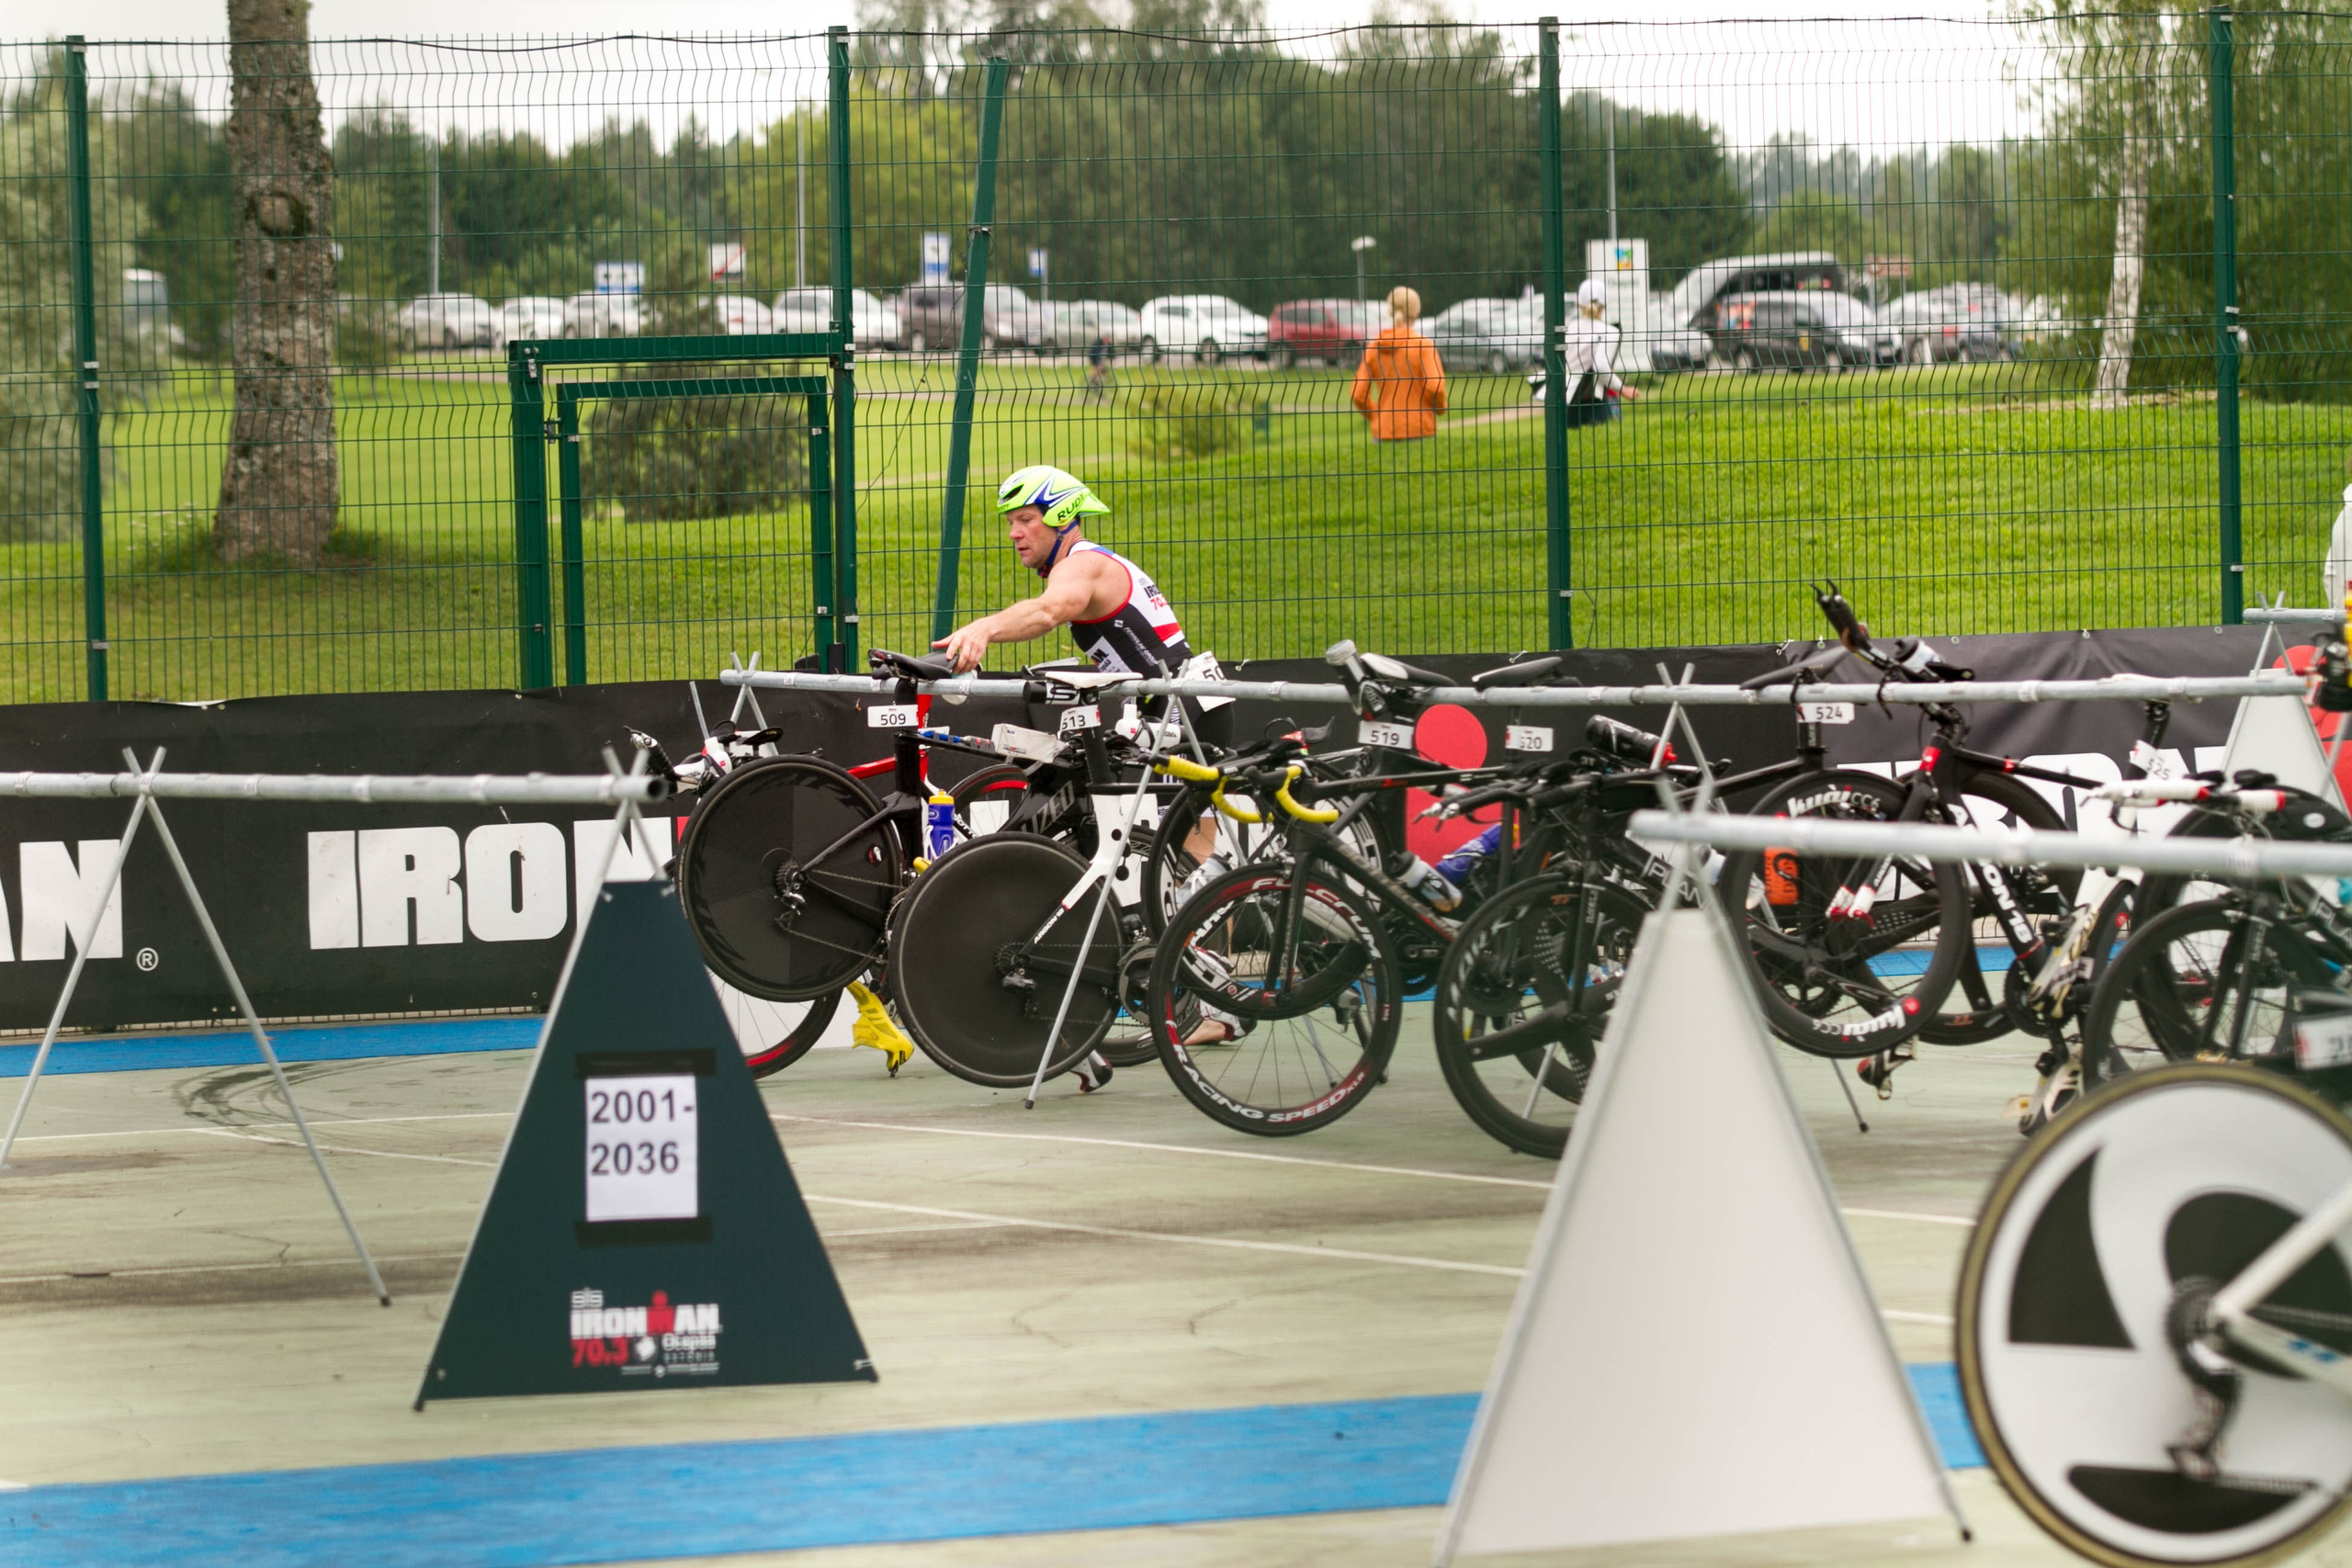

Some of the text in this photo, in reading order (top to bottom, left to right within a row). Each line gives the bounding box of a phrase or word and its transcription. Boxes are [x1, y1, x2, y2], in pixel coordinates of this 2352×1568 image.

[880, 714, 906, 726] 509
[1062, 715, 1085, 729] 513
[1816, 706, 1842, 719] 524
[1371, 730, 1399, 745] 519
[2147, 759, 2169, 780] 525
[0, 840, 123, 962] N
[308, 818, 682, 950] IRON
[1252, 878, 1383, 959] FUCRUM
[1173, 1043, 1264, 1120] RACING
[1267, 1088, 1346, 1122] SPEED
[591, 1089, 695, 1123] 2001-
[591, 1142, 680, 1176] 2036
[571, 1292, 719, 1339] IRONMAN
[571, 1337, 629, 1368] 70.3
